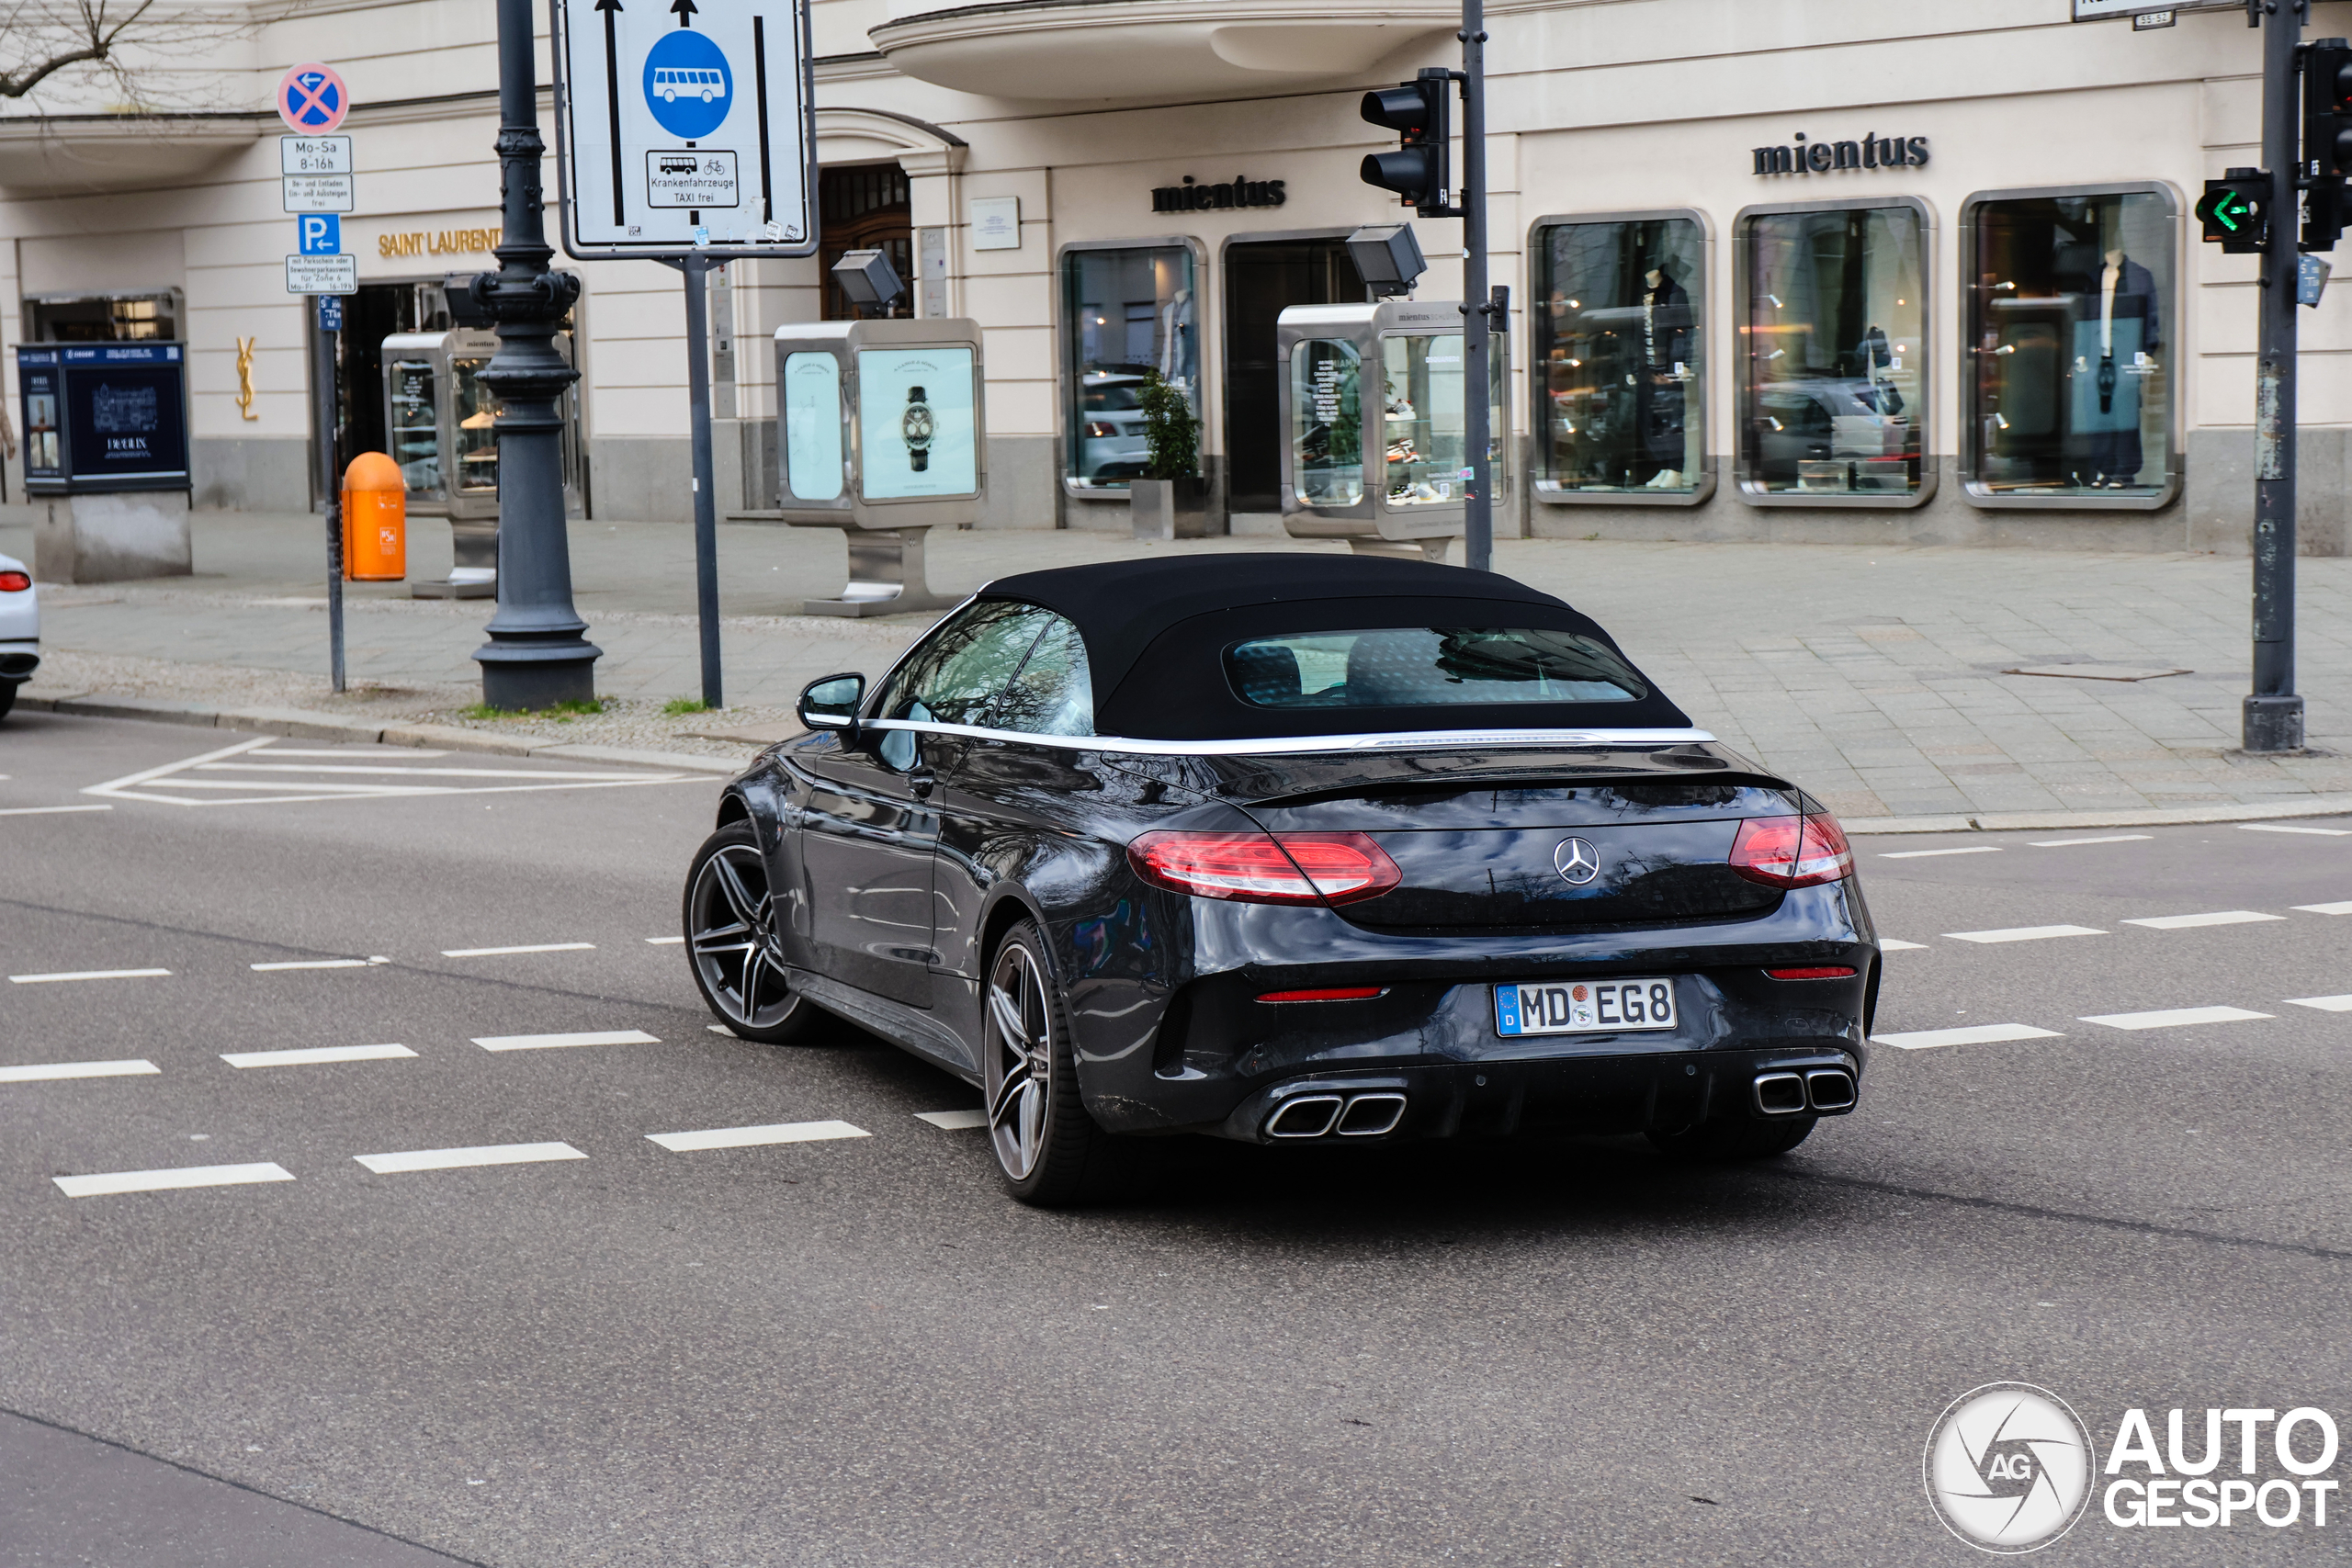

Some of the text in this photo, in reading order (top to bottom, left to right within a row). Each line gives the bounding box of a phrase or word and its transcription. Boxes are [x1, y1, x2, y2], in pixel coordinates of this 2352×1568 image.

[2141, 13, 2167, 25] 55-52
[296, 141, 336, 153] Mo-Sa
[1751, 131, 1928, 175] mientus
[300, 158, 334, 170] 8-16h
[651, 178, 734, 189] Krankenfahrzeuge
[316, 189, 347, 198] Aussteigen
[673, 192, 714, 202] TAXI frei
[1151, 175, 1285, 213] mientus
[1440, 188, 1448, 204] F4
[304, 217, 328, 251] P
[379, 227, 503, 257] SAINT LAURENT
[1398, 312, 1430, 321] mientus
[1521, 987, 1570, 1027] MD
[1505, 1015, 1514, 1026] D
